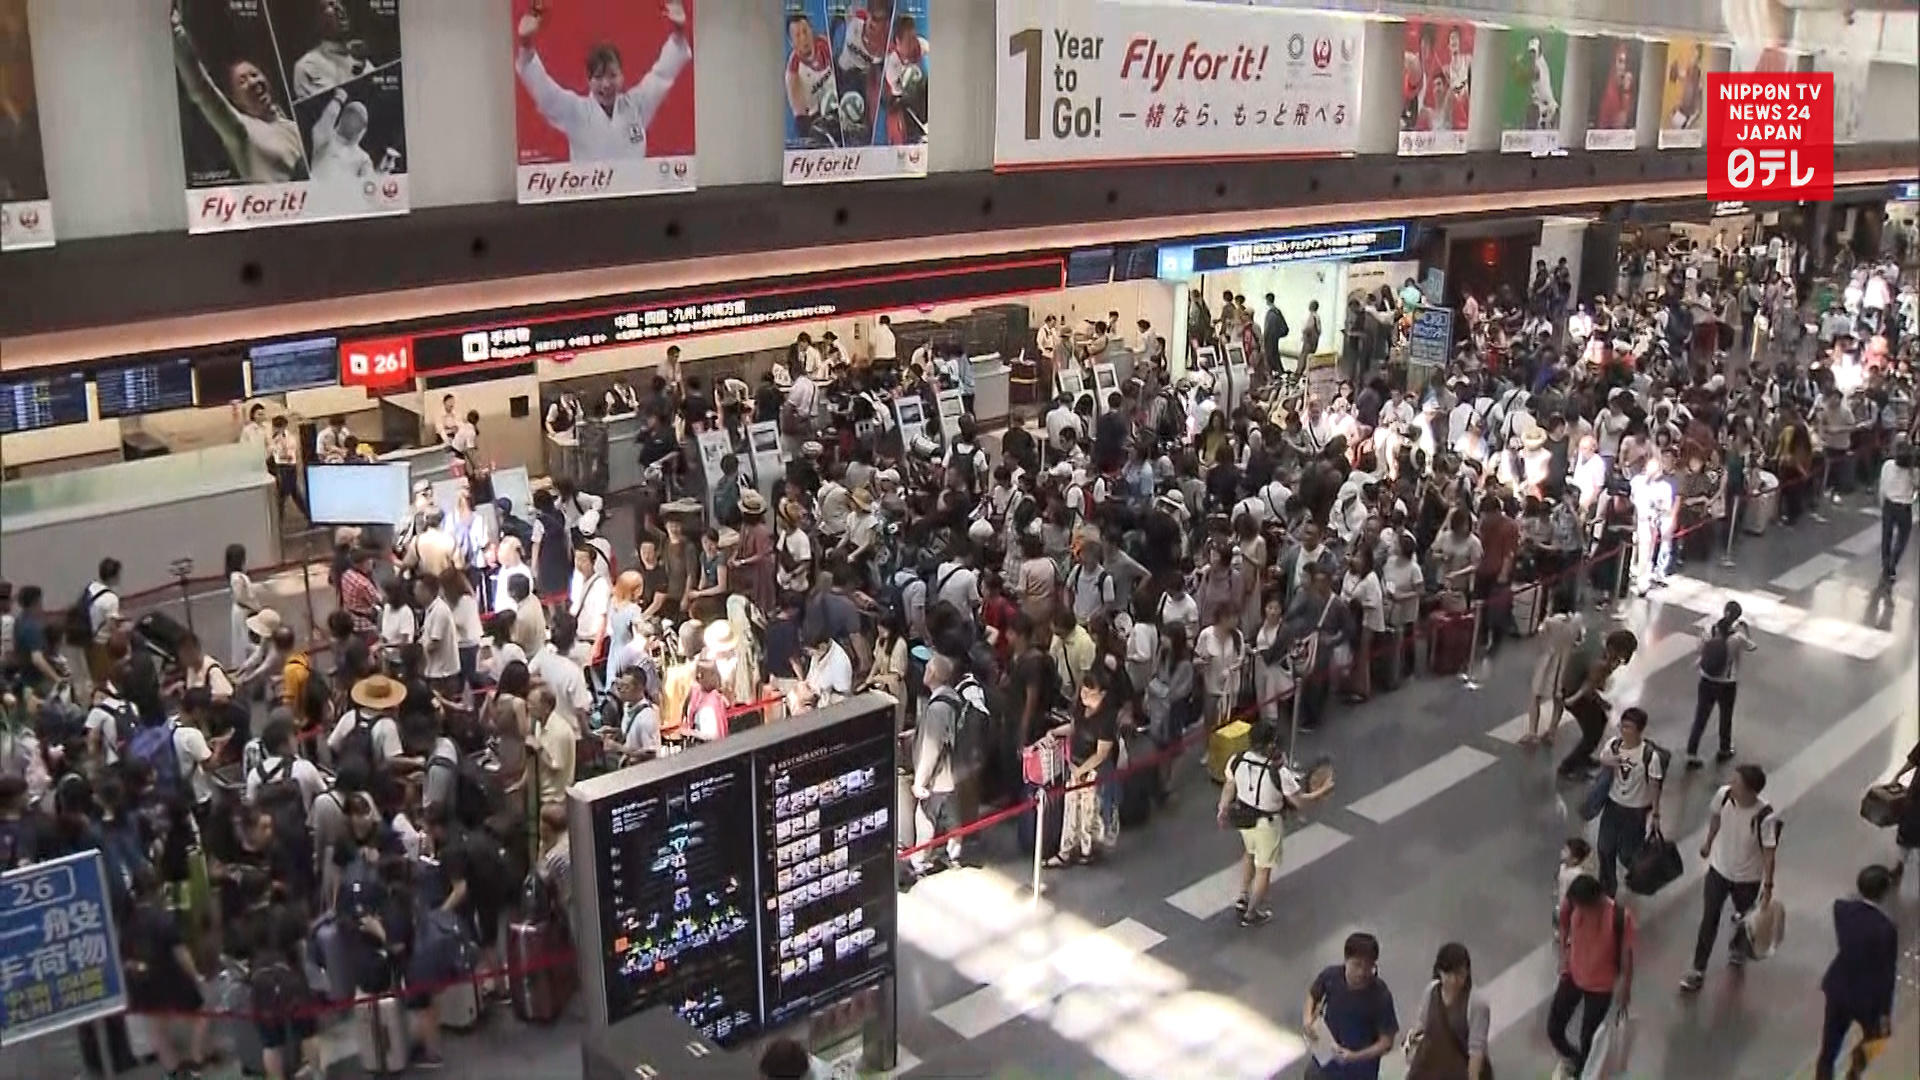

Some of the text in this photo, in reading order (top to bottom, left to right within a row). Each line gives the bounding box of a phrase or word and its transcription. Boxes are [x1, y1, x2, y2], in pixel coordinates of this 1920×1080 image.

[1053, 28, 1104, 60] Year
[1053, 65, 1077, 92] to
[1120, 39, 1270, 92] Fly for it!
[1008, 28, 1043, 141] 1
[1052, 97, 1101, 140] Go!
[527, 169, 614, 194] Fly for it!
[790, 155, 861, 178] Fly for it!
[201, 191, 307, 222] Fly for it!
[373, 353, 399, 373] 26
[13, 878, 55, 905] 26
[0, 935, 107, 991] 手荷物
